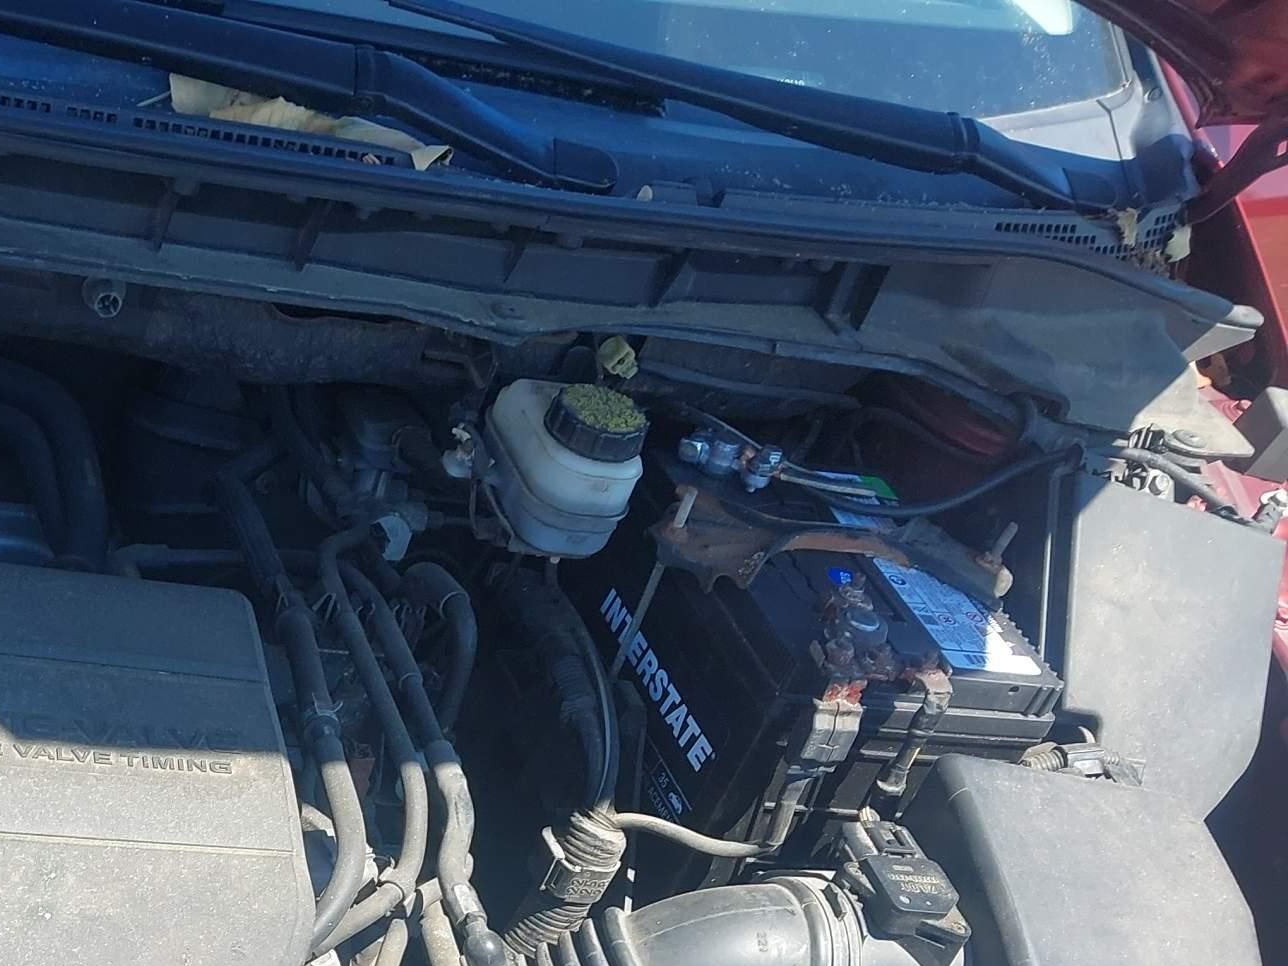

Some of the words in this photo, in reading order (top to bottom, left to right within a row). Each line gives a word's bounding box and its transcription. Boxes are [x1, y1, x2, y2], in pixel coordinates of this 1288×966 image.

[600, 588, 712, 773] INTERSTATE
[13, 742, 113, 766] VALVE
[120, 753, 233, 774] TIMING
